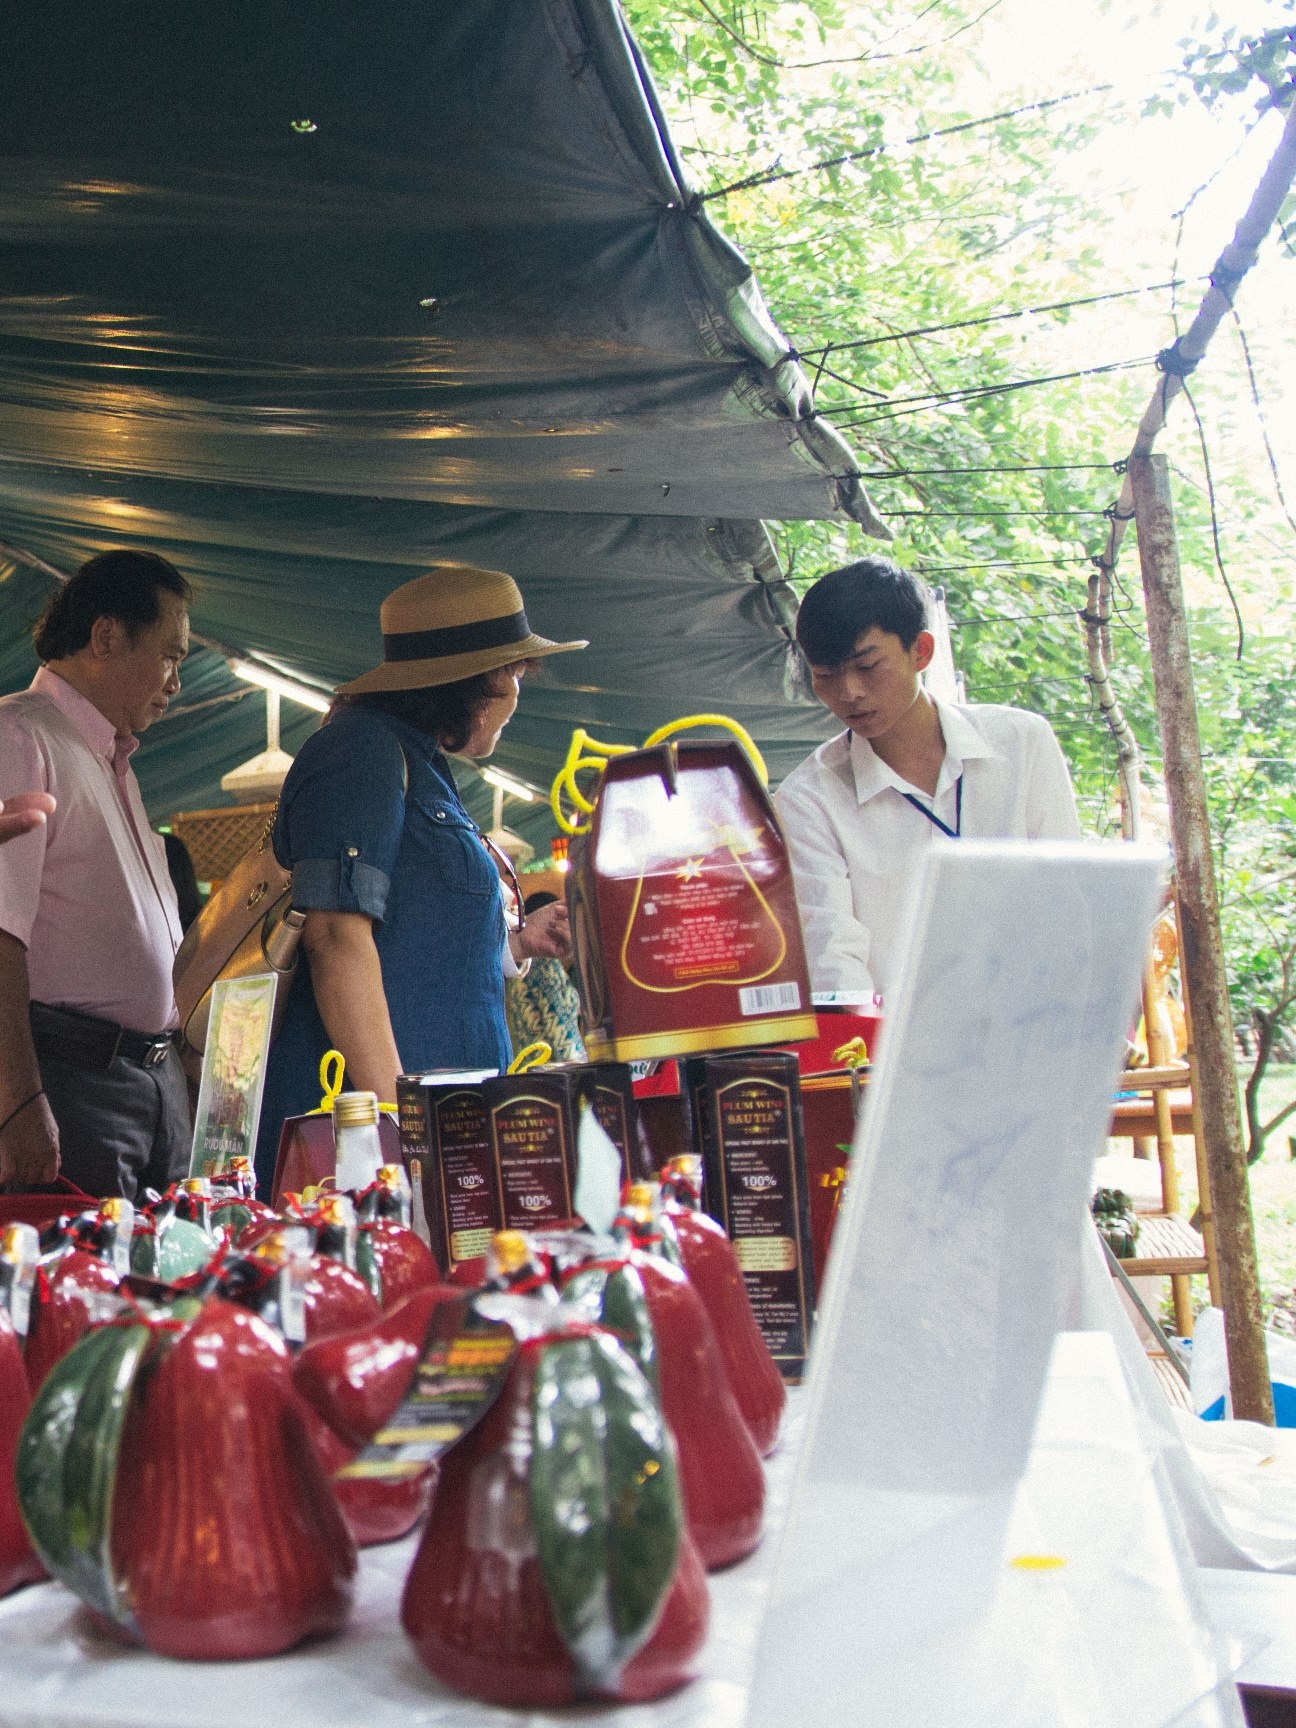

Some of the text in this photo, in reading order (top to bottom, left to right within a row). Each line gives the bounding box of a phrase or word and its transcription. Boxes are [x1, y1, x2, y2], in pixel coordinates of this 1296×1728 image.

[457, 1174, 484, 1186] 100%
[742, 1175, 777, 1187] 100%
[519, 1194, 552, 1207] 100%
